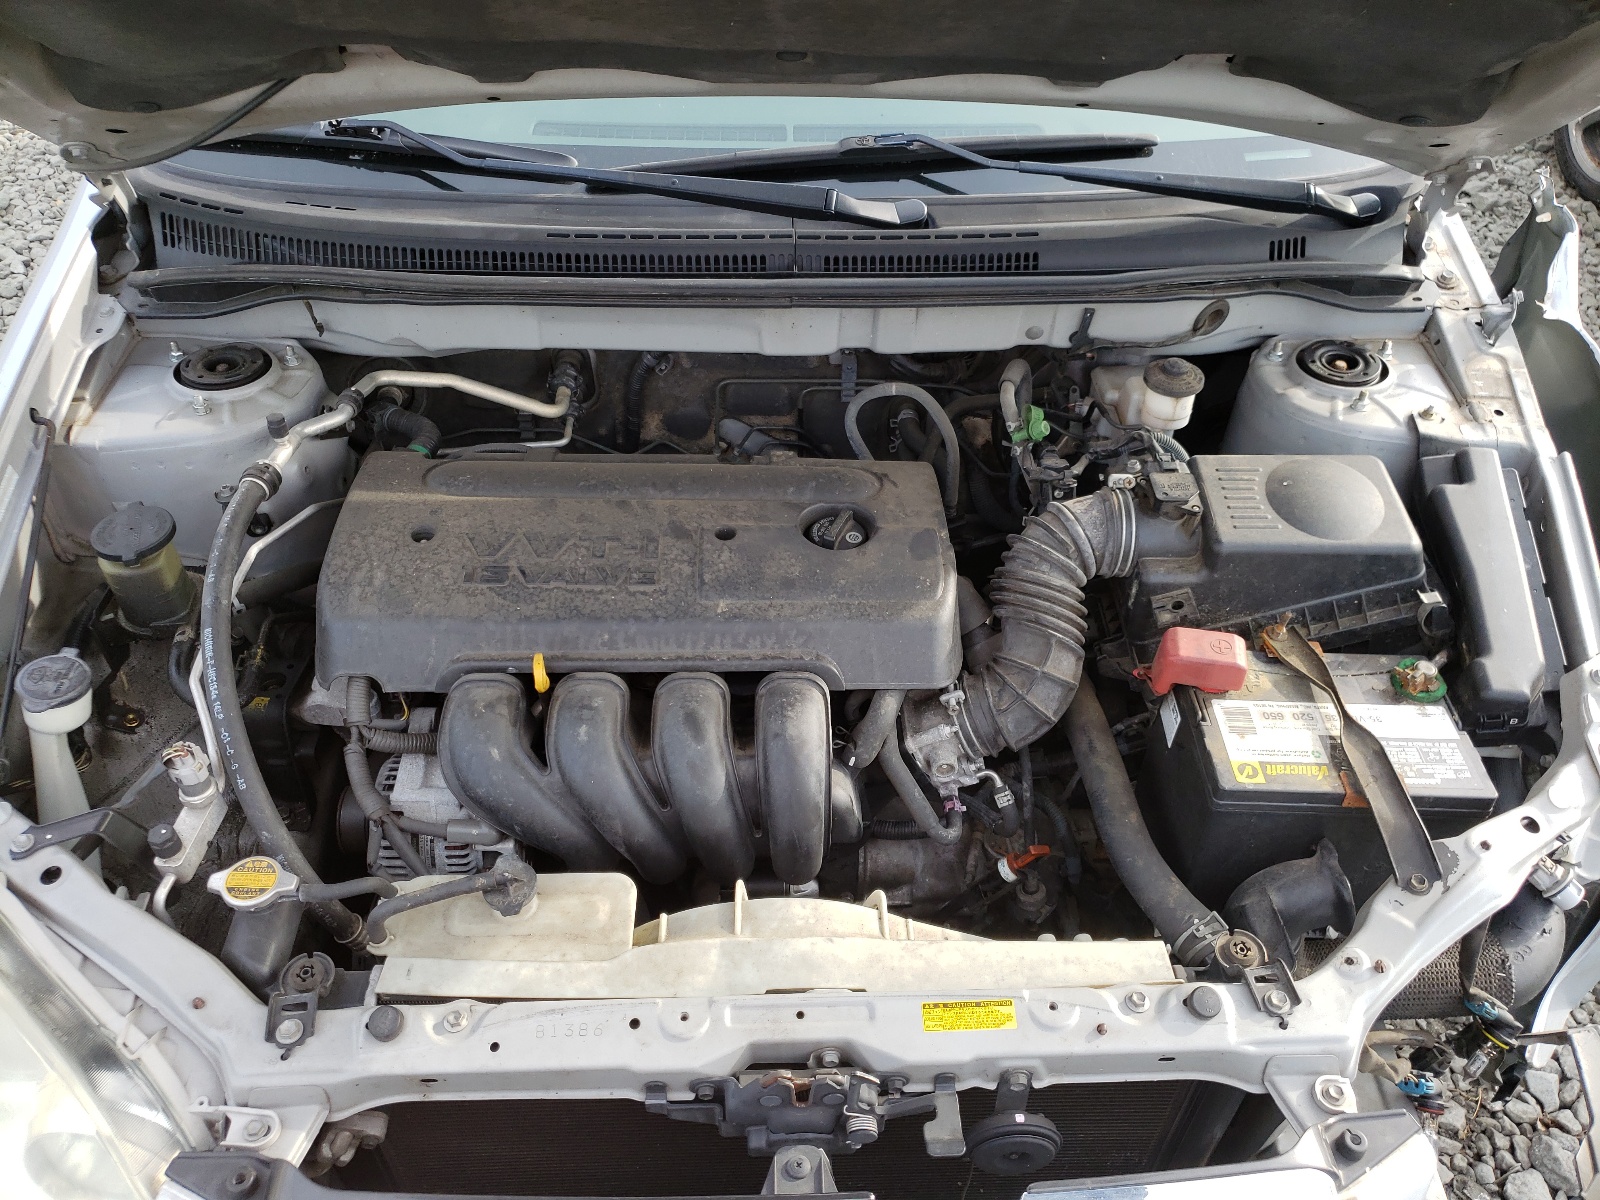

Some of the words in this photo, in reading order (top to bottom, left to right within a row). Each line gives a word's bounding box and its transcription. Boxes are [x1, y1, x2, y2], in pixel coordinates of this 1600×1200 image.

[515, 565, 660, 588] VALVE
[1262, 711, 1284, 720] 650
[1292, 712, 1314, 721] 520
[1265, 763, 1329, 781] Valucraft
[535, 1022, 603, 1039] 81386
